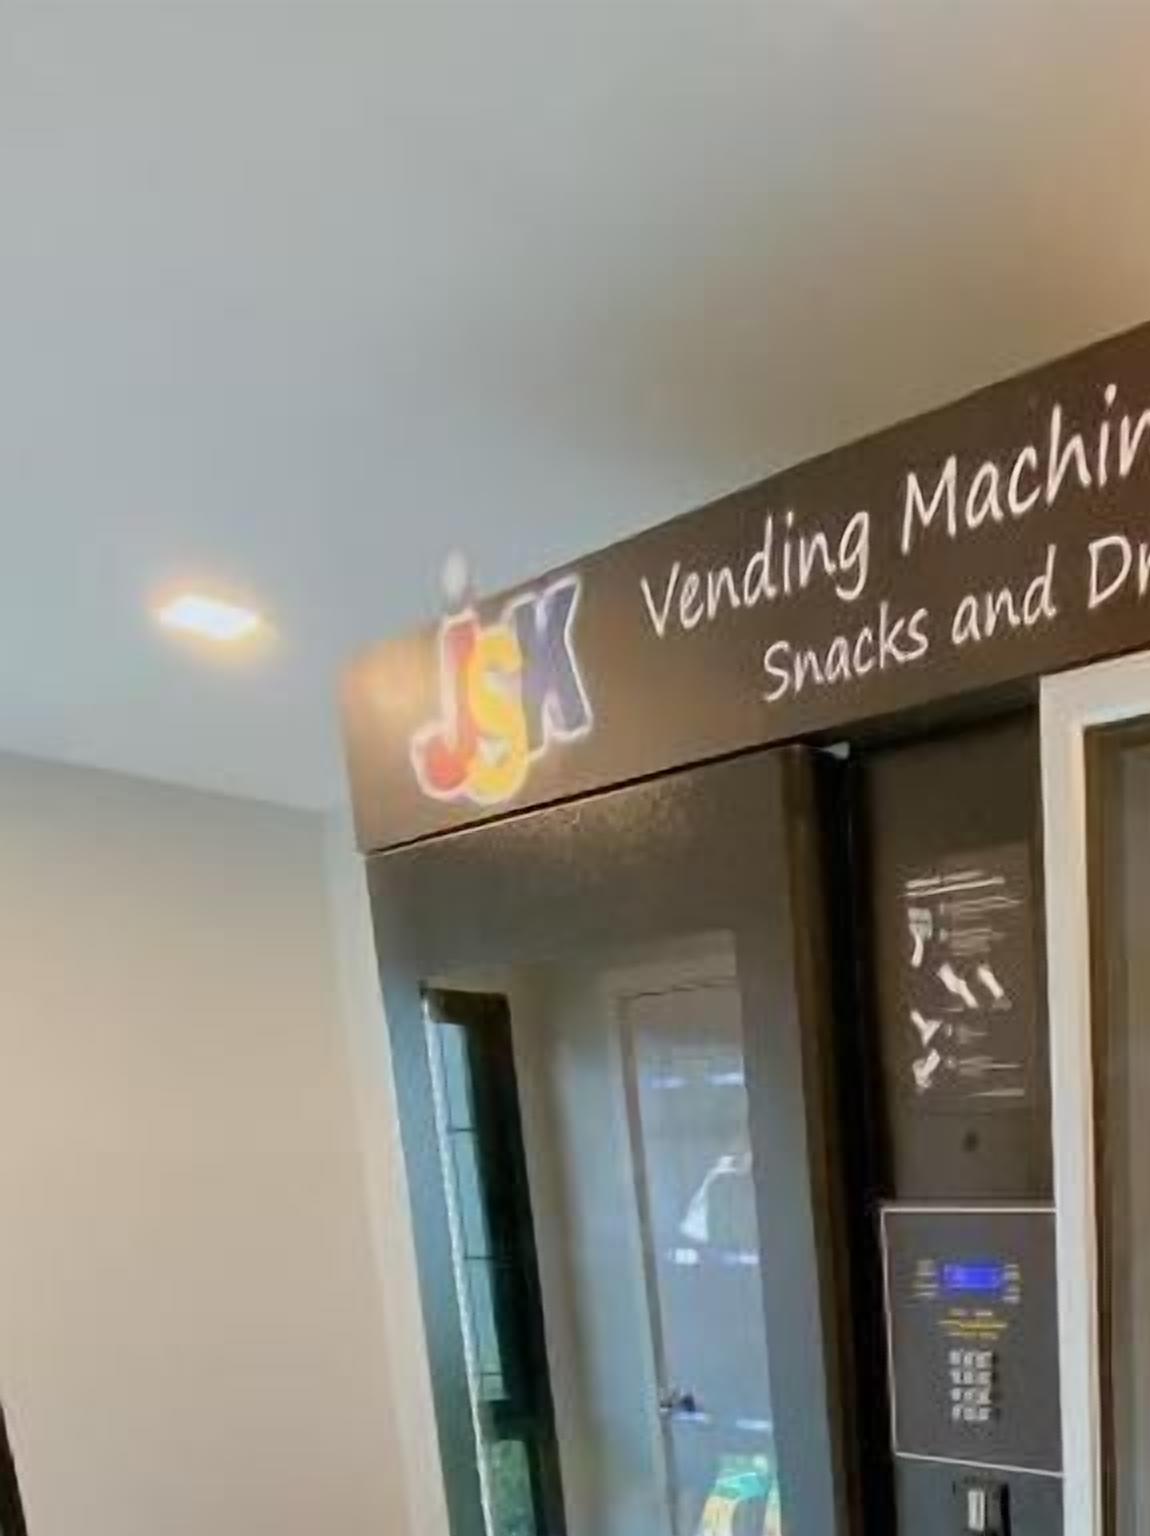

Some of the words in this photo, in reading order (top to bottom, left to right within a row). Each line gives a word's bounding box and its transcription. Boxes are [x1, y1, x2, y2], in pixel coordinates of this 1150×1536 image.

[640, 510, 871, 638] Vending
[761, 602, 929, 703] Snacks
[951, 544, 1057, 645] and
